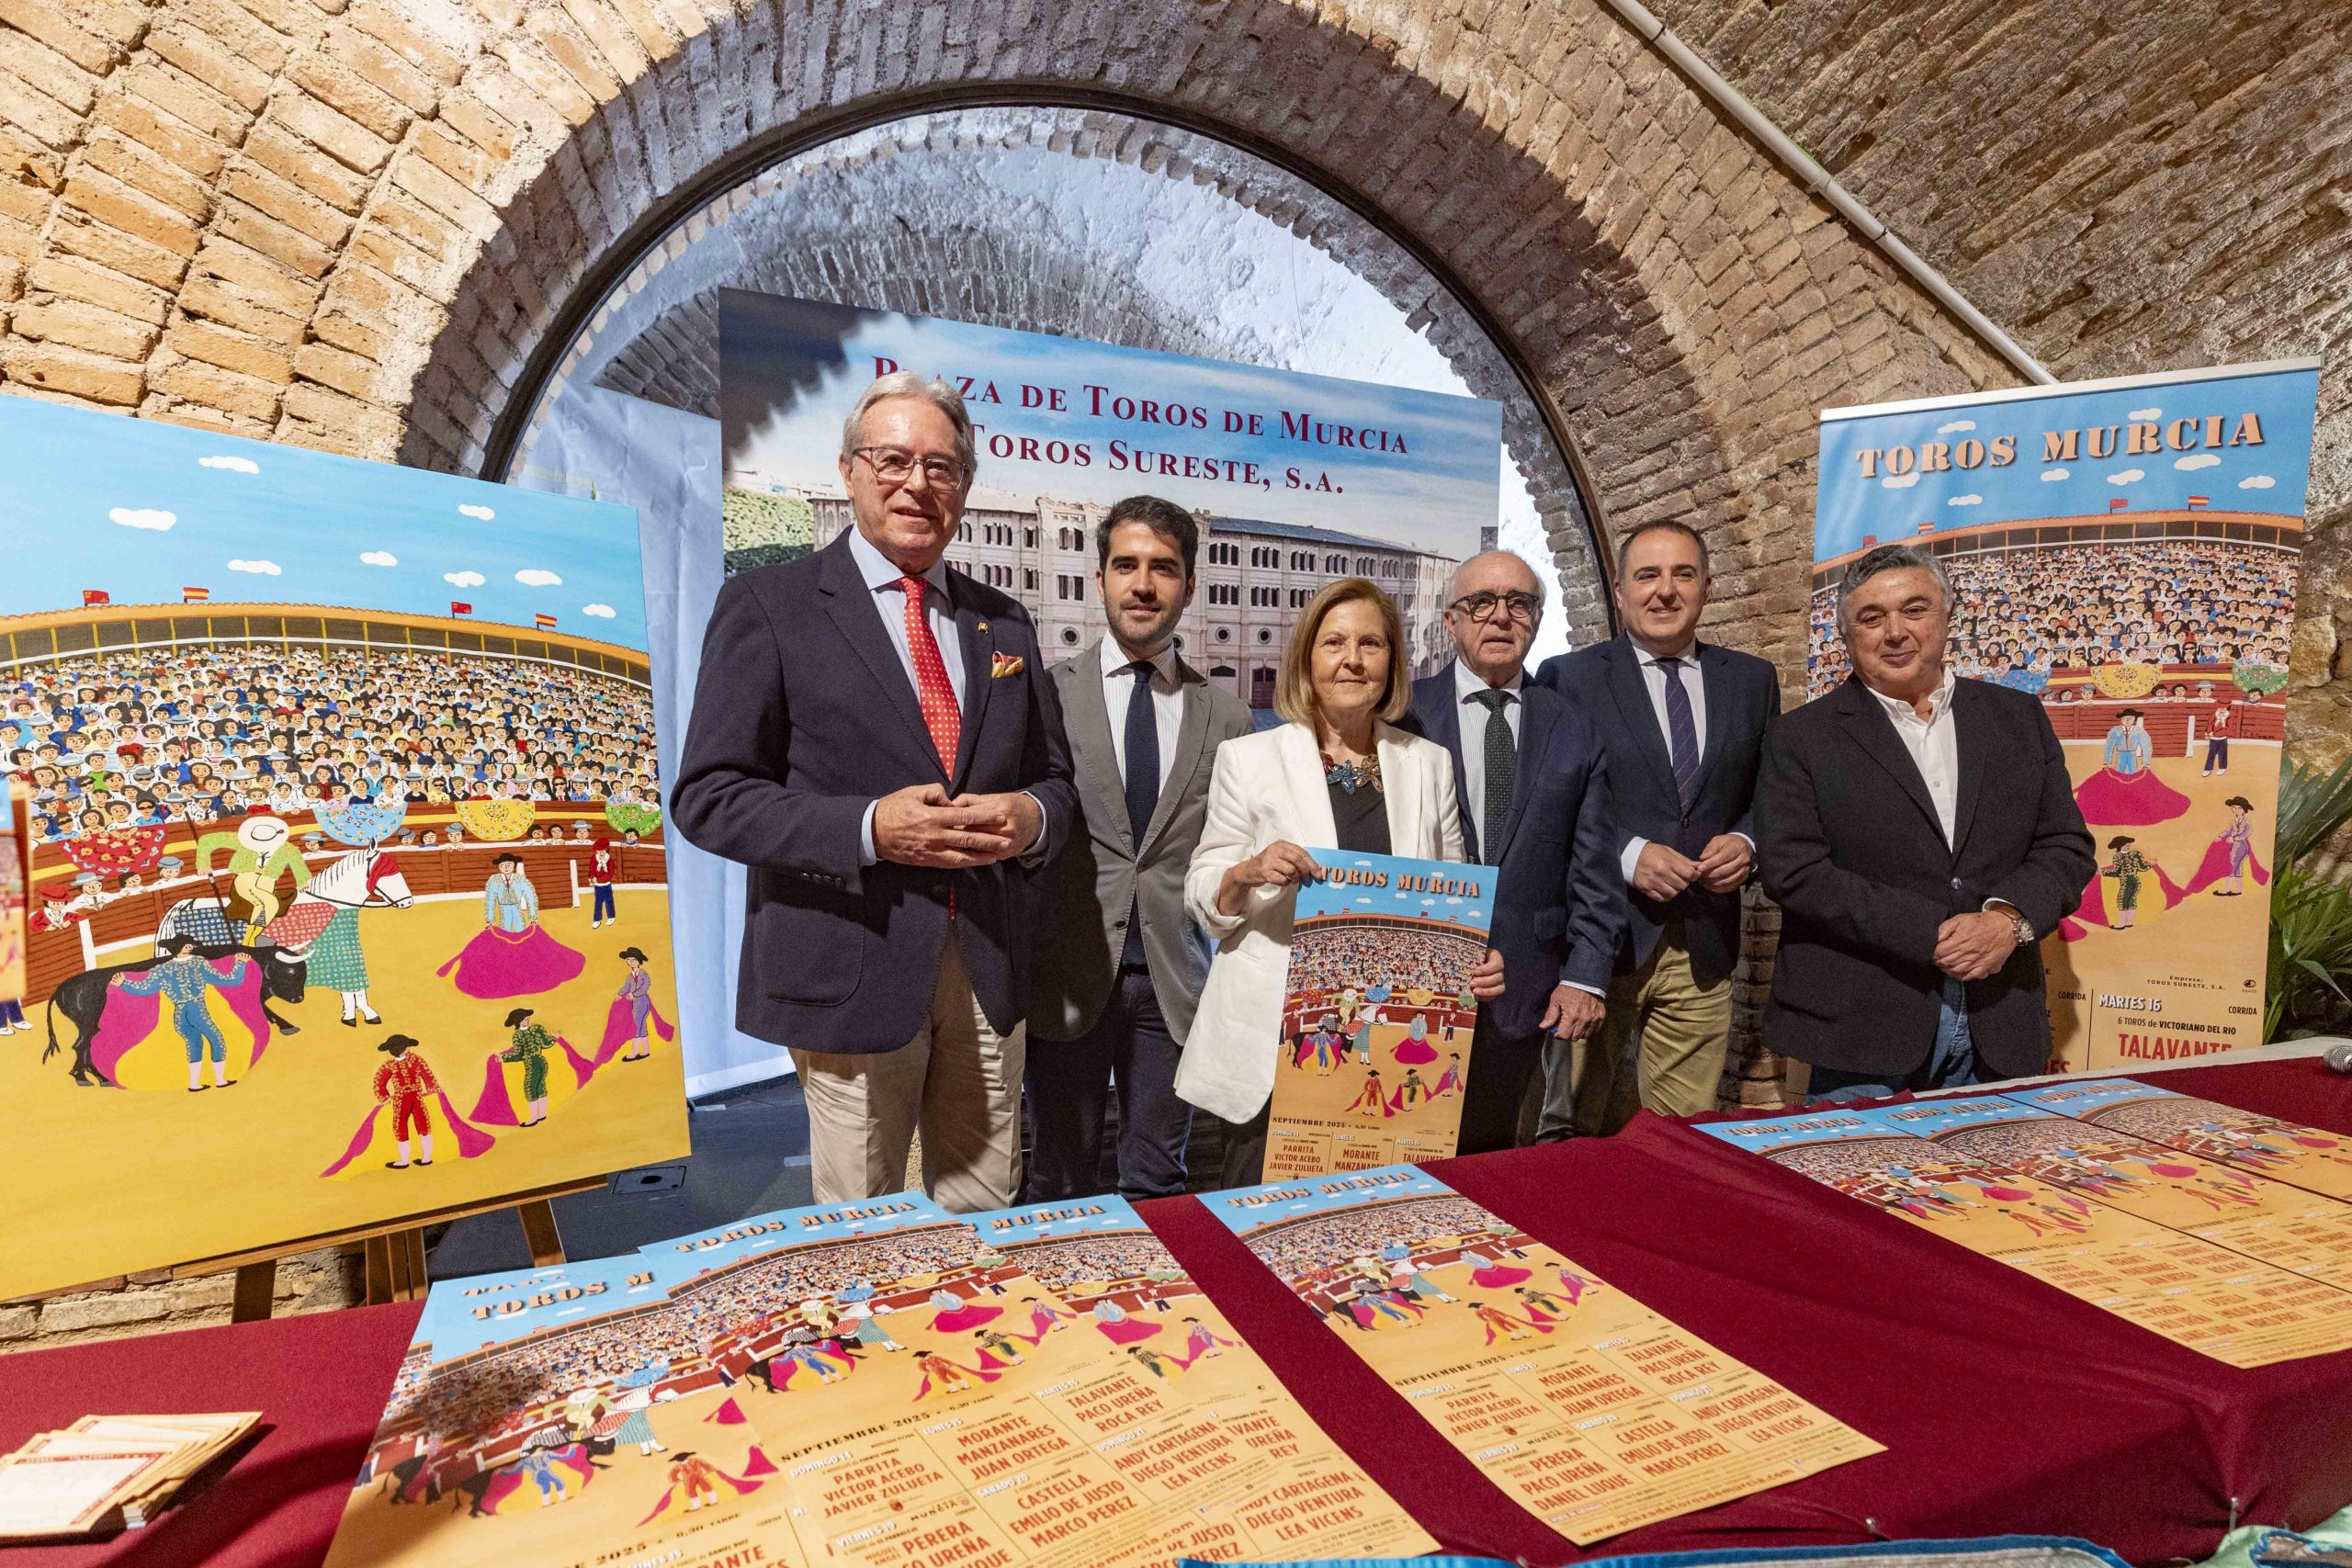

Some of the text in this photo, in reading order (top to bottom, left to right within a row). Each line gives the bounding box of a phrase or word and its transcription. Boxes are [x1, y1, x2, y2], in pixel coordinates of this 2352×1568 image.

[872, 356, 1408, 454] PZA DE TOROS DE MURCIA
[1856, 412, 2265, 479] TOROS MURCIA
[1109, 439, 1271, 492] SURESTE,
[1285, 467, 1343, 494] S.A.
[1318, 865, 1480, 897] TOROS MURCIA
[2058, 991, 2086, 1000] CORRIDA
[2098, 994, 2162, 1011] MARTES 16
[2228, 1006, 2257, 1015] CORRIDA
[2124, 1017, 2146, 1027] TOROS
[2148, 1020, 2157, 1028] de
[2159, 1021, 2205, 1032] VICTORIANO
[2207, 1025, 2220, 1034] DEL
[2223, 1027, 2236, 1035] RIO
[1272, 1116, 1323, 1126] SEPTIEMBRE
[1274, 1154, 1297, 1162] VICTOR
[1283, 1145, 1315, 1153] PARRITA
[1343, 1149, 1380, 1161] MORANTE
[1269, 1162, 1323, 1173] JAVIER ZULUETA
[1227, 1171, 1416, 1209] TOROS MURCIA
[674, 1201, 918, 1254] TOROS MURCIA
[990, 1204, 1106, 1229] MURCIA
[470, 1281, 606, 1319] TOROS
[1624, 1338, 1689, 1362] TALAVANTE
[1637, 1348, 1710, 1376] PACO UREÑA
[1395, 1362, 1473, 1388] SEPTIEMBRE
[1477, 1355, 1507, 1368] 2025
[1537, 1364, 1600, 1387] MORANTE
[1660, 1360, 1722, 1386] ROCA REY
[1066, 1376, 1140, 1409] TALAVANTE
[1075, 1385, 1159, 1423] PACO UREÑA
[1446, 1391, 1500, 1410] PARRITA
[1544, 1373, 1626, 1403] MANZANARES
[1562, 1385, 1645, 1416] JUAN ORTEGA
[1691, 1404, 1728, 1421] ANDY
[1722, 1384, 1784, 1412] CARTAGENA
[1094, 1412, 1136, 1432] ROCA
[1136, 1400, 1166, 1416] REY
[1444, 1397, 1522, 1424] VICTOR ACEBO
[1450, 1404, 1541, 1436] JAVIER ZULUETA
[1713, 1397, 1804, 1434] DIEGO VENTURA
[782, 1424, 888, 1462] SEPTIEMBRE
[893, 1412, 931, 1427] 2025
[922, 1421, 951, 1437] LUNES
[956, 1424, 1057, 1465] MANZANARES
[957, 1416, 1033, 1448] MORANTE
[1246, 1427, 1296, 1449] UREÑA
[1615, 1419, 1679, 1445] CASTELLA
[1747, 1415, 1815, 1443] LEA VICENS
[973, 1454, 1012, 1482] JUAN
[1012, 1437, 1071, 1465] ORTEGA
[1114, 1450, 1154, 1472] ANDY
[1152, 1421, 1219, 1456] CARTAGENA
[1131, 1460, 1176, 1483] DIEGO
[1171, 1436, 1234, 1463] VENTURA
[1271, 1444, 1301, 1460] REY
[1529, 1447, 1588, 1472] PERERA
[1617, 1428, 1713, 1465] EMILIO DE JUSTO
[1641, 1455, 1690, 1477] MARCO
[1686, 1442, 1731, 1463] PEREZ
[790, 1455, 839, 1477] DOMINGO
[833, 1457, 902, 1484] PARRITA
[1161, 1474, 1189, 1491] LEA
[1188, 1452, 1237, 1481] VICENS
[1520, 1461, 1610, 1495] PACO UREÑA
[823, 1463, 926, 1502] VICTOR ACEBO
[824, 1495, 877, 1517] JAVIER
[882, 1471, 944, 1499] ZULUETA
[1016, 1474, 1091, 1509] CASTELLA
[1272, 1471, 1353, 1501] CARTAGENA
[1532, 1488, 1589, 1511] DANIEL
[1583, 1473, 1634, 1495] LUQUE
[1009, 1506, 1061, 1535] EMILIO
[1059, 1495, 1081, 1514] DE
[1082, 1480, 1125, 1505] JUSTO
[1030, 1516, 1089, 1548] MARCO
[1087, 1495, 1137, 1524] PEREZ
[1246, 1486, 1366, 1529] DIEGO VENTURA
[1275, 1506, 1363, 1541] LEA VICENS
[902, 1520, 974, 1555] PERERA
[1191, 1523, 1236, 1547] JUSTO
[928, 1536, 991, 1568] UREÑA
